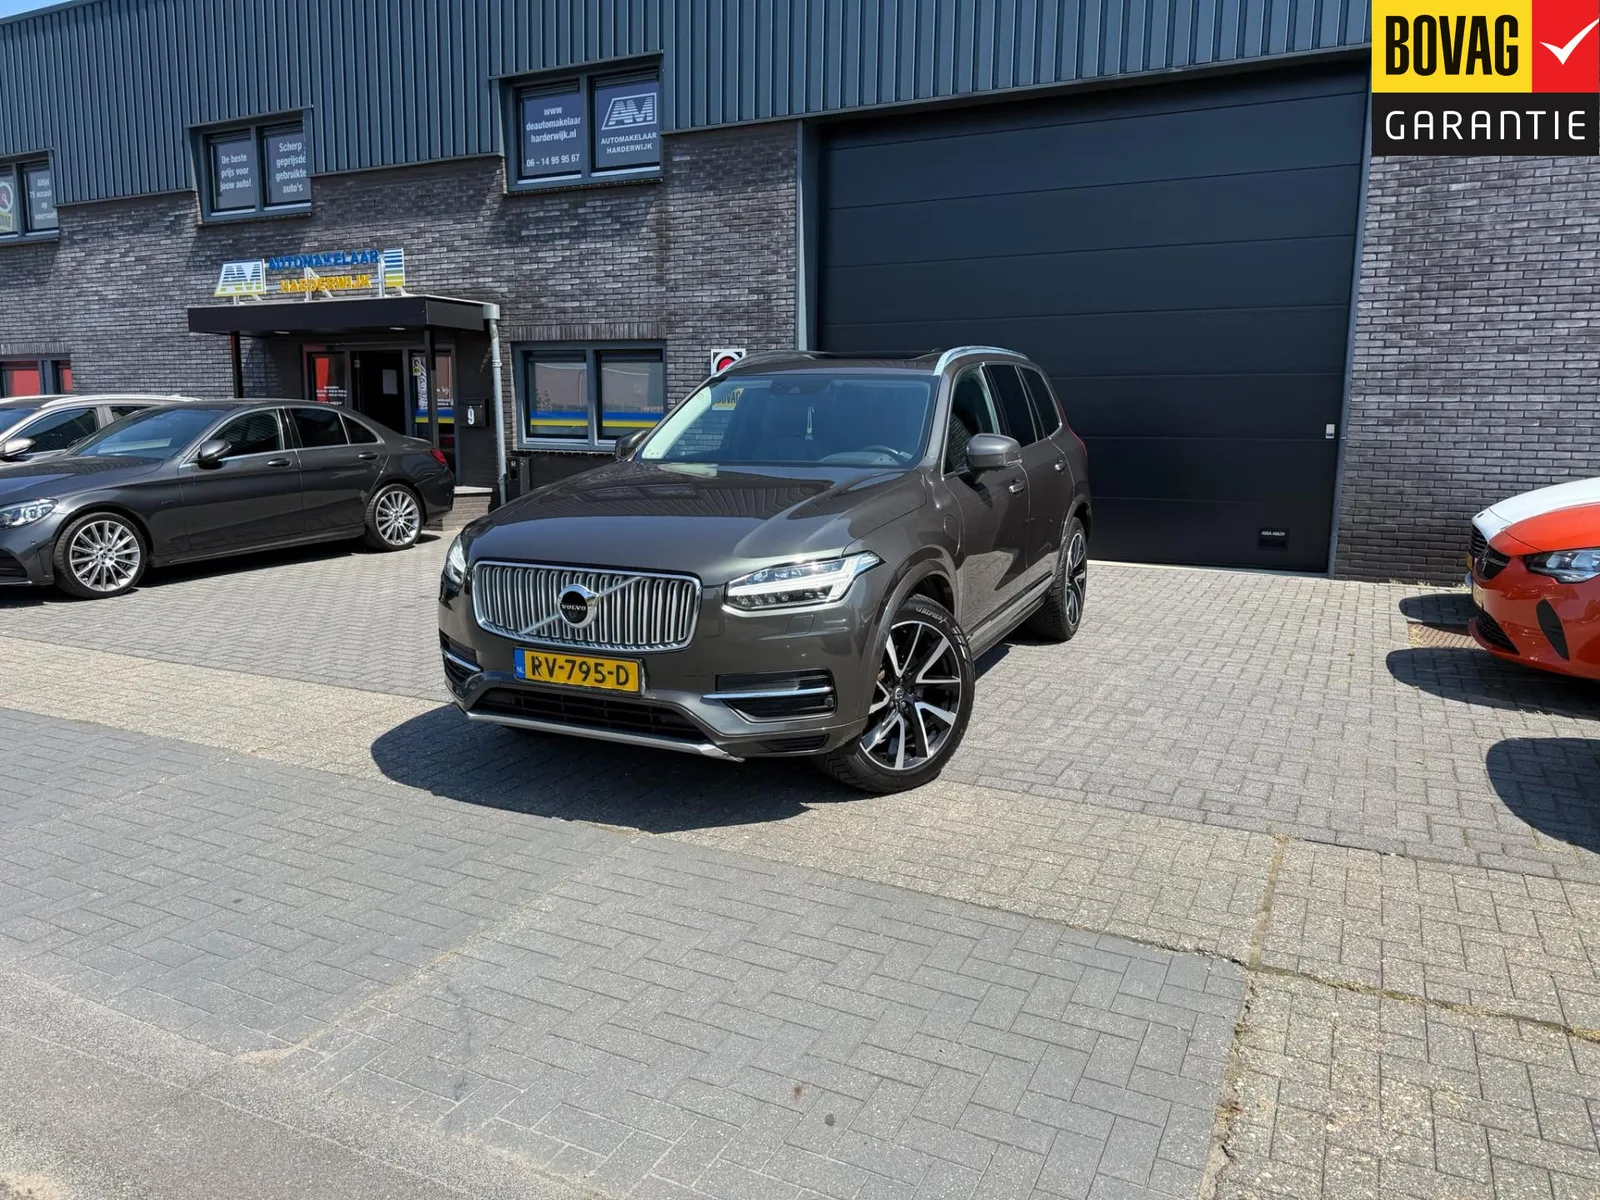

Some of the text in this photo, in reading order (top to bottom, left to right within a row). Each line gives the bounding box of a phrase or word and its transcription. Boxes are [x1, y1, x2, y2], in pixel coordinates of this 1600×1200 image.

[543, 106, 563, 116] www
[526, 116, 581, 131] deautomakelaar
[530, 129, 577, 144] harderwijk.nl
[601, 132, 658, 145] AUTOMAKELAAR
[279, 142, 302, 152] Scherp
[606, 142, 653, 155] HARDERWIJK
[221, 154, 247, 164] De beste
[276, 155, 306, 168] geprijsde
[526, 158, 535, 168] 06
[541, 156, 550, 166] 14
[551, 155, 560, 165] 95
[561, 154, 570, 164] 95
[571, 153, 580, 163] 67
[221, 167, 249, 179] prijs voor
[276, 168, 307, 182] gebruikte
[220, 178, 252, 192] jouw auto!
[282, 182, 303, 194] auto's
[268, 249, 380, 271] AUTOMAKELAAR
[280, 274, 372, 293] HARDERWIJK
[467, 408, 475, 425] 9
[561, 603, 587, 611] VOLVO
[530, 655, 630, 686] RV-795-D
